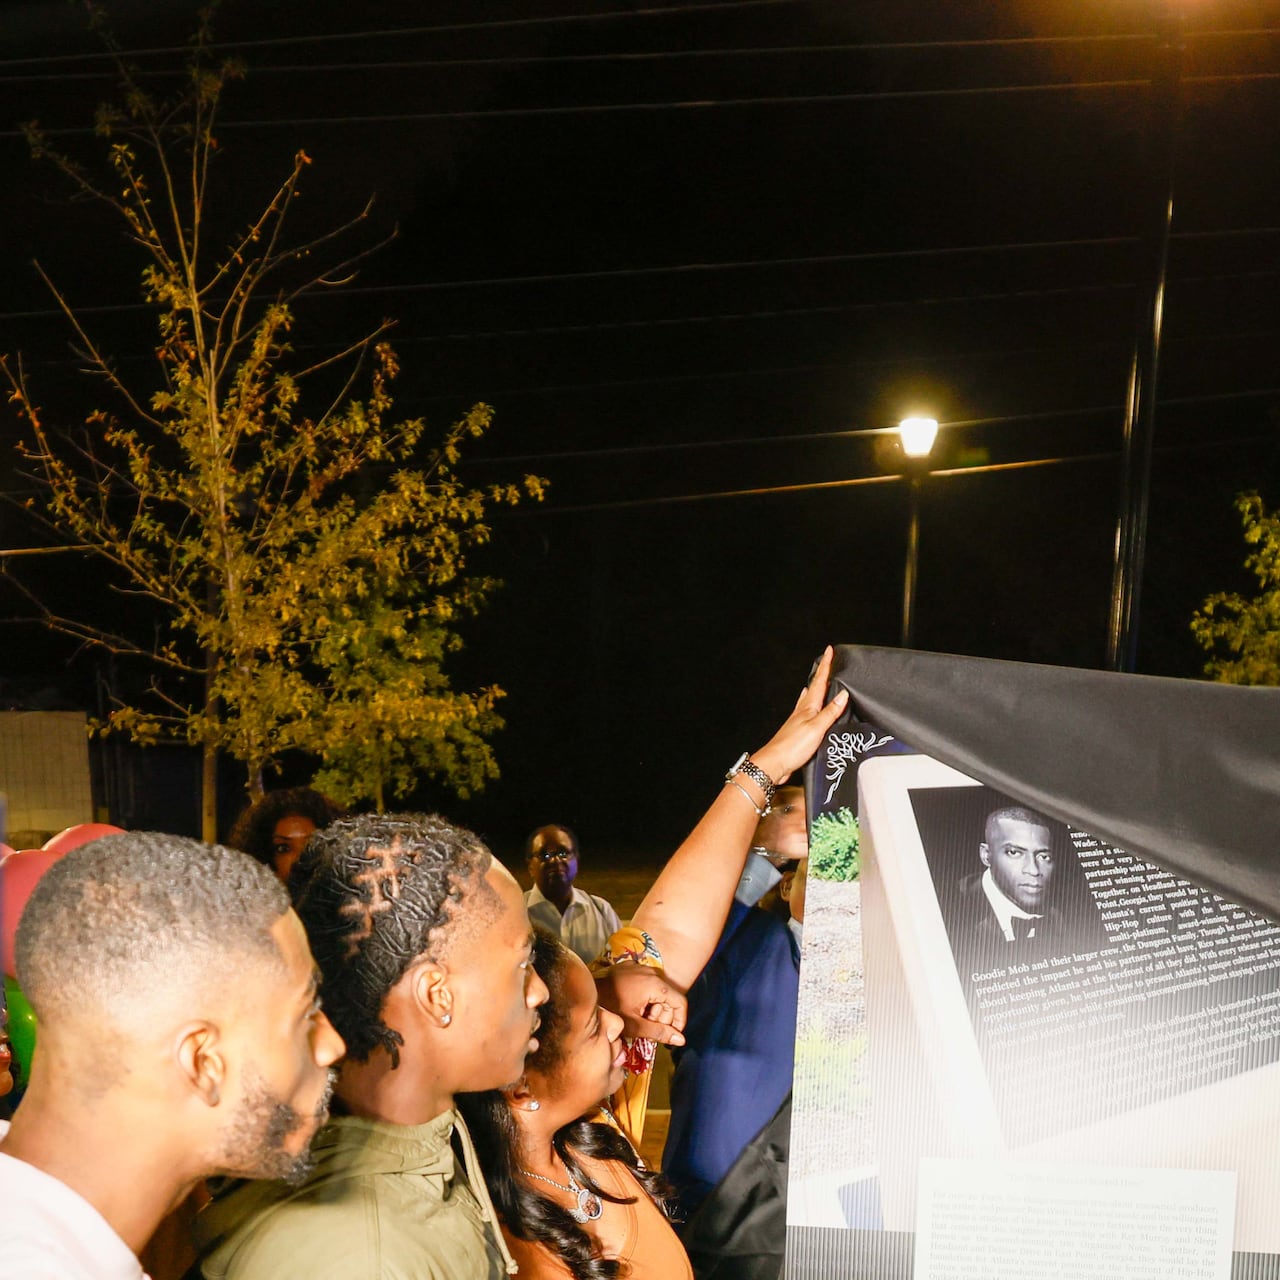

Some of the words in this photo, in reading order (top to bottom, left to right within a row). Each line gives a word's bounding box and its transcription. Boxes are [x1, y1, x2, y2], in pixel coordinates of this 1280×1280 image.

[1085, 868, 1128, 879] partnership
[1129, 864, 1145, 872] with
[1089, 880, 1112, 888] award
[1115, 876, 1144, 884] winning
[1092, 888, 1129, 899] Together,
[1143, 880, 1176, 891] Headland
[1096, 901, 1120, 910] Point,
[1119, 897, 1148, 906] Georgia,
[1148, 893, 1164, 903] they
[1165, 890, 1186, 898] would
[1188, 888, 1198, 896] lay
[1101, 909, 1134, 920] Atlanta's
[1140, 904, 1166, 913] current
[1171, 898, 1198, 910] position
[1104, 920, 1139, 932] Hip-Hop
[1147, 914, 1172, 924] culture
[1179, 909, 1194, 918] with
[1202, 906, 1213, 914] the
[1178, 915, 1229, 929] award-winning
[972, 968, 1006, 983] Goodie
[1008, 963, 1029, 975] Mob
[1031, 959, 1048, 970] and
[1050, 955, 1071, 967] their
[1073, 951, 1098, 964] larger
[1100, 947, 1121, 956] crew,
[1123, 942, 1135, 952] the
[1137, 937, 1171, 950] Dungeon
[1172, 931, 1198, 943] Family.
[1198, 927, 1226, 937] Though
[1226, 923, 1235, 931] he
[1236, 920, 1253, 930] could
[976, 978, 1020, 998] predicted
[1024, 976, 1039, 986] the
[1040, 969, 1071, 982] impact
[1072, 966, 1084, 974] he
[1086, 962, 1102, 972] and
[1103, 958, 1117, 968] his
[1119, 952, 1152, 967] partners
[1153, 946, 1175, 958] would
[1177, 942, 1197, 953] have,
[1198, 939, 1214, 948] Rico
[1230, 931, 1251, 944] always
[980, 996, 1007, 1008] about
[1009, 989, 1047, 1003] keeping
[1049, 982, 1080, 994] Atlanta
[1092, 972, 1107, 983] the
[1108, 966, 1144, 980] forefront
[1155, 960, 1166, 970] all
[1166, 957, 1182, 969] they
[1199, 950, 1217, 960] With
[1218, 947, 1236, 957] every
[1237, 942, 1260, 952] release
[1261, 937, 1273, 947] and
[983, 1005, 1040, 1022] opportunity
[1042, 999, 1069, 1012] given,
[1071, 994, 1082, 1003] he
[1083, 987, 1115, 999] learned
[1116, 982, 1133, 991] how
[1145, 973, 1174, 986] present
[1175, 966, 1208, 978] Atlanta's
[1208, 959, 1232, 971] unique
[1232, 954, 1256, 966] culture
[1256, 951, 1269, 960] and
[1079, 1004, 1102, 1014] while
[1104, 992, 1147, 1008] remaining
[1146, 978, 1209, 998] uncompromising
